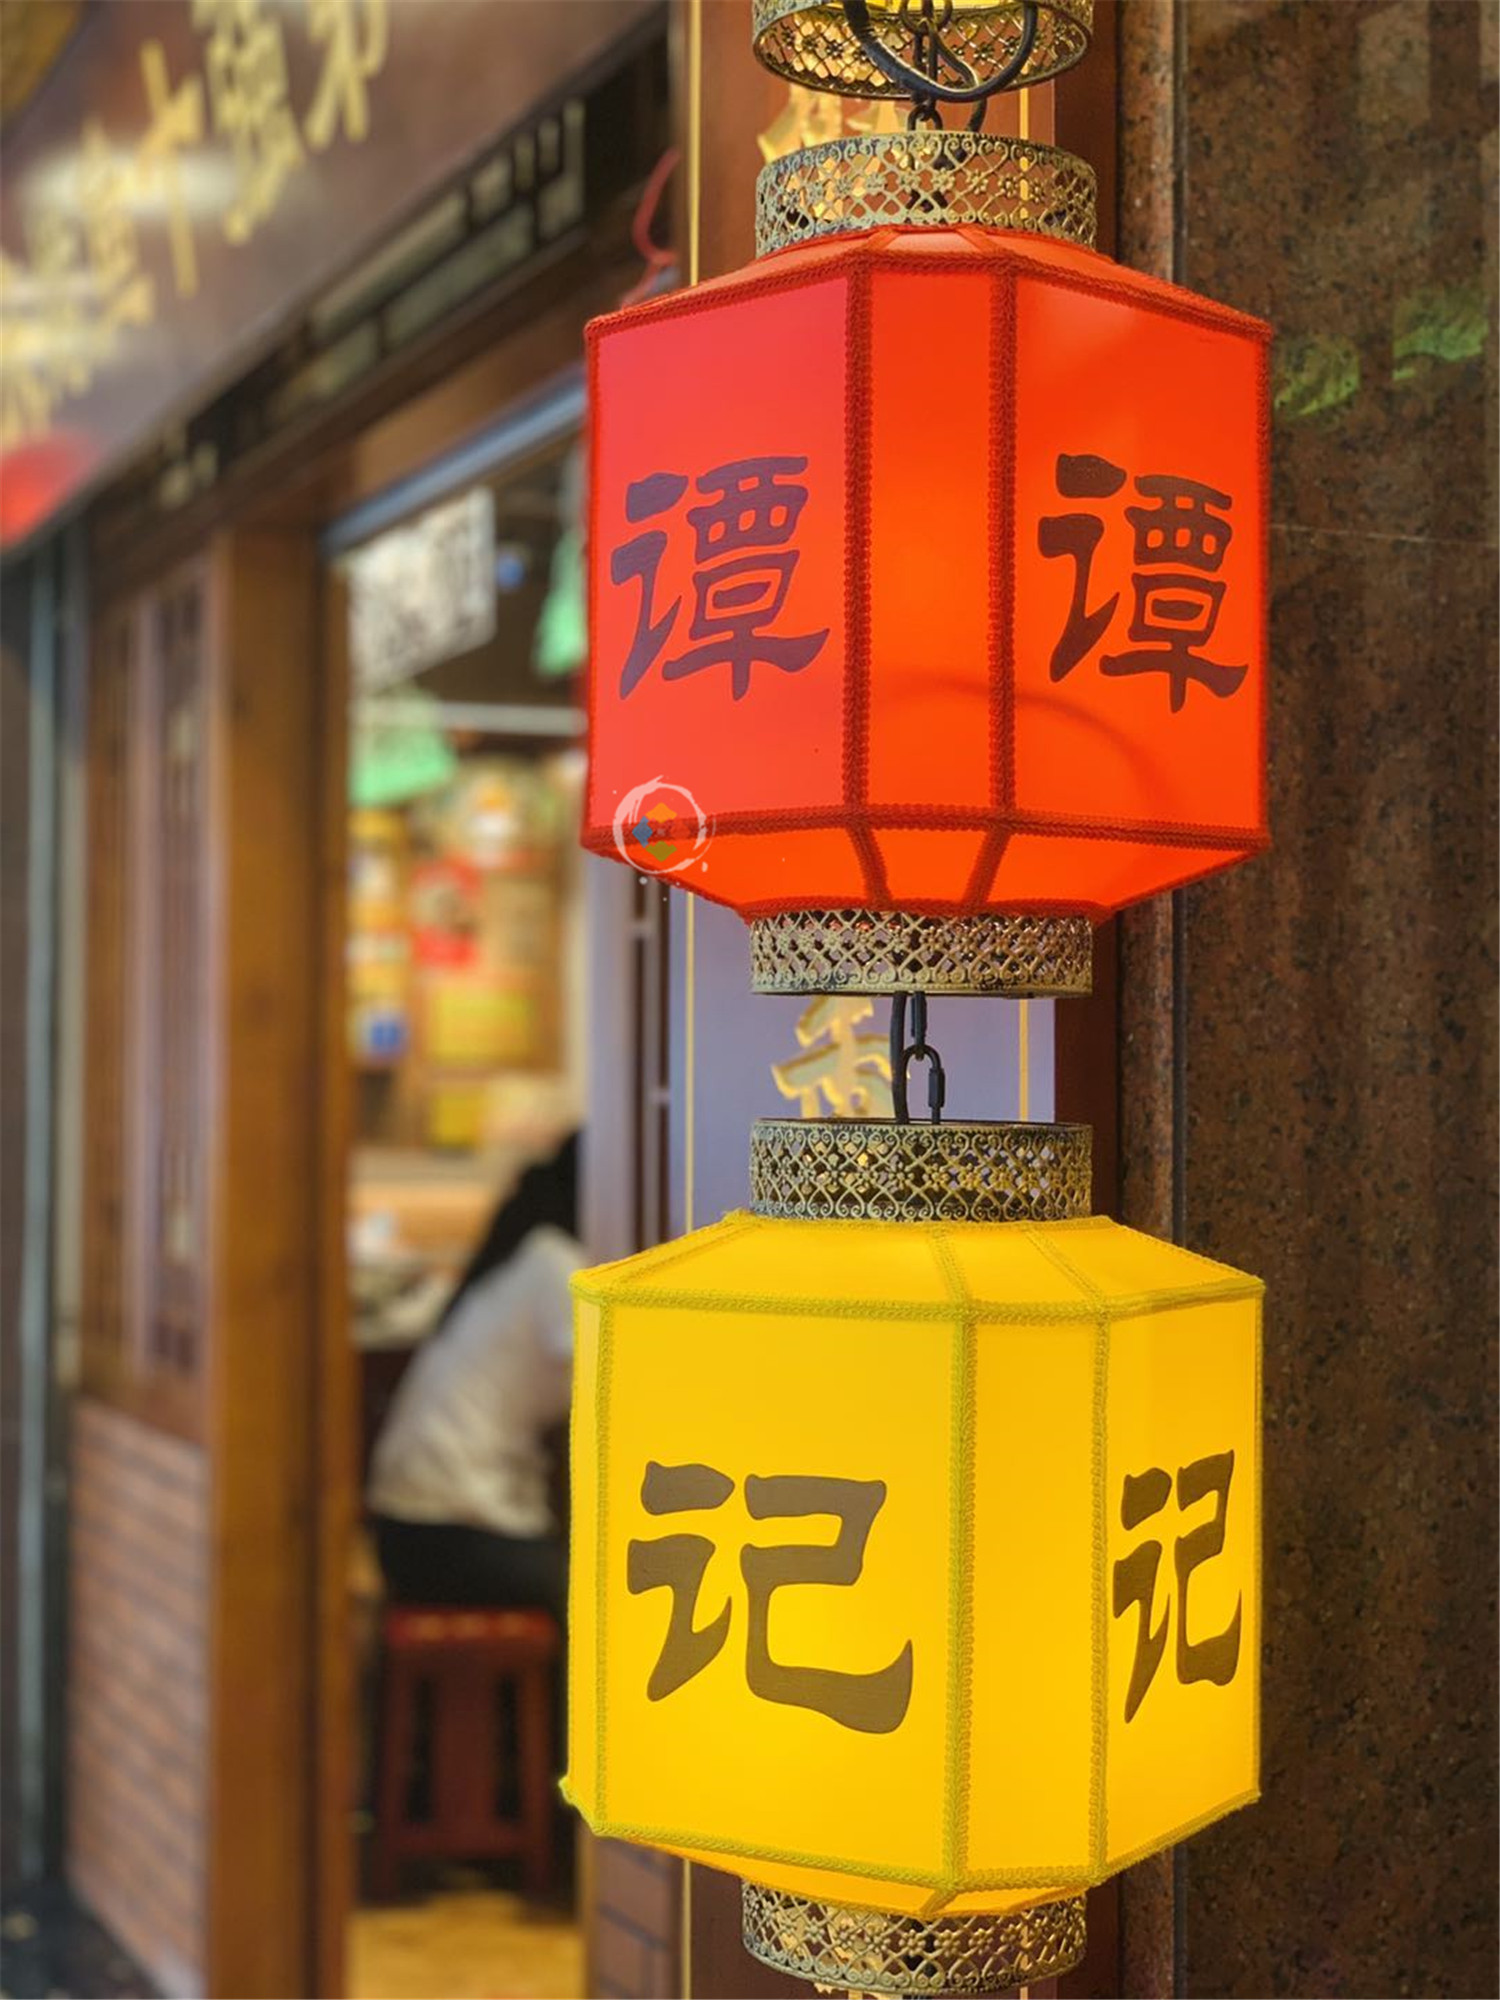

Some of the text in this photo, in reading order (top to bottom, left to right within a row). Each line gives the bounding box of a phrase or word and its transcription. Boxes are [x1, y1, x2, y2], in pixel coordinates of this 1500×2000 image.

[611, 456, 829, 700] 谭
[1038, 453, 1249, 712] 谭
[627, 1461, 914, 1734] 记
[1113, 1449, 1242, 1724] 记
